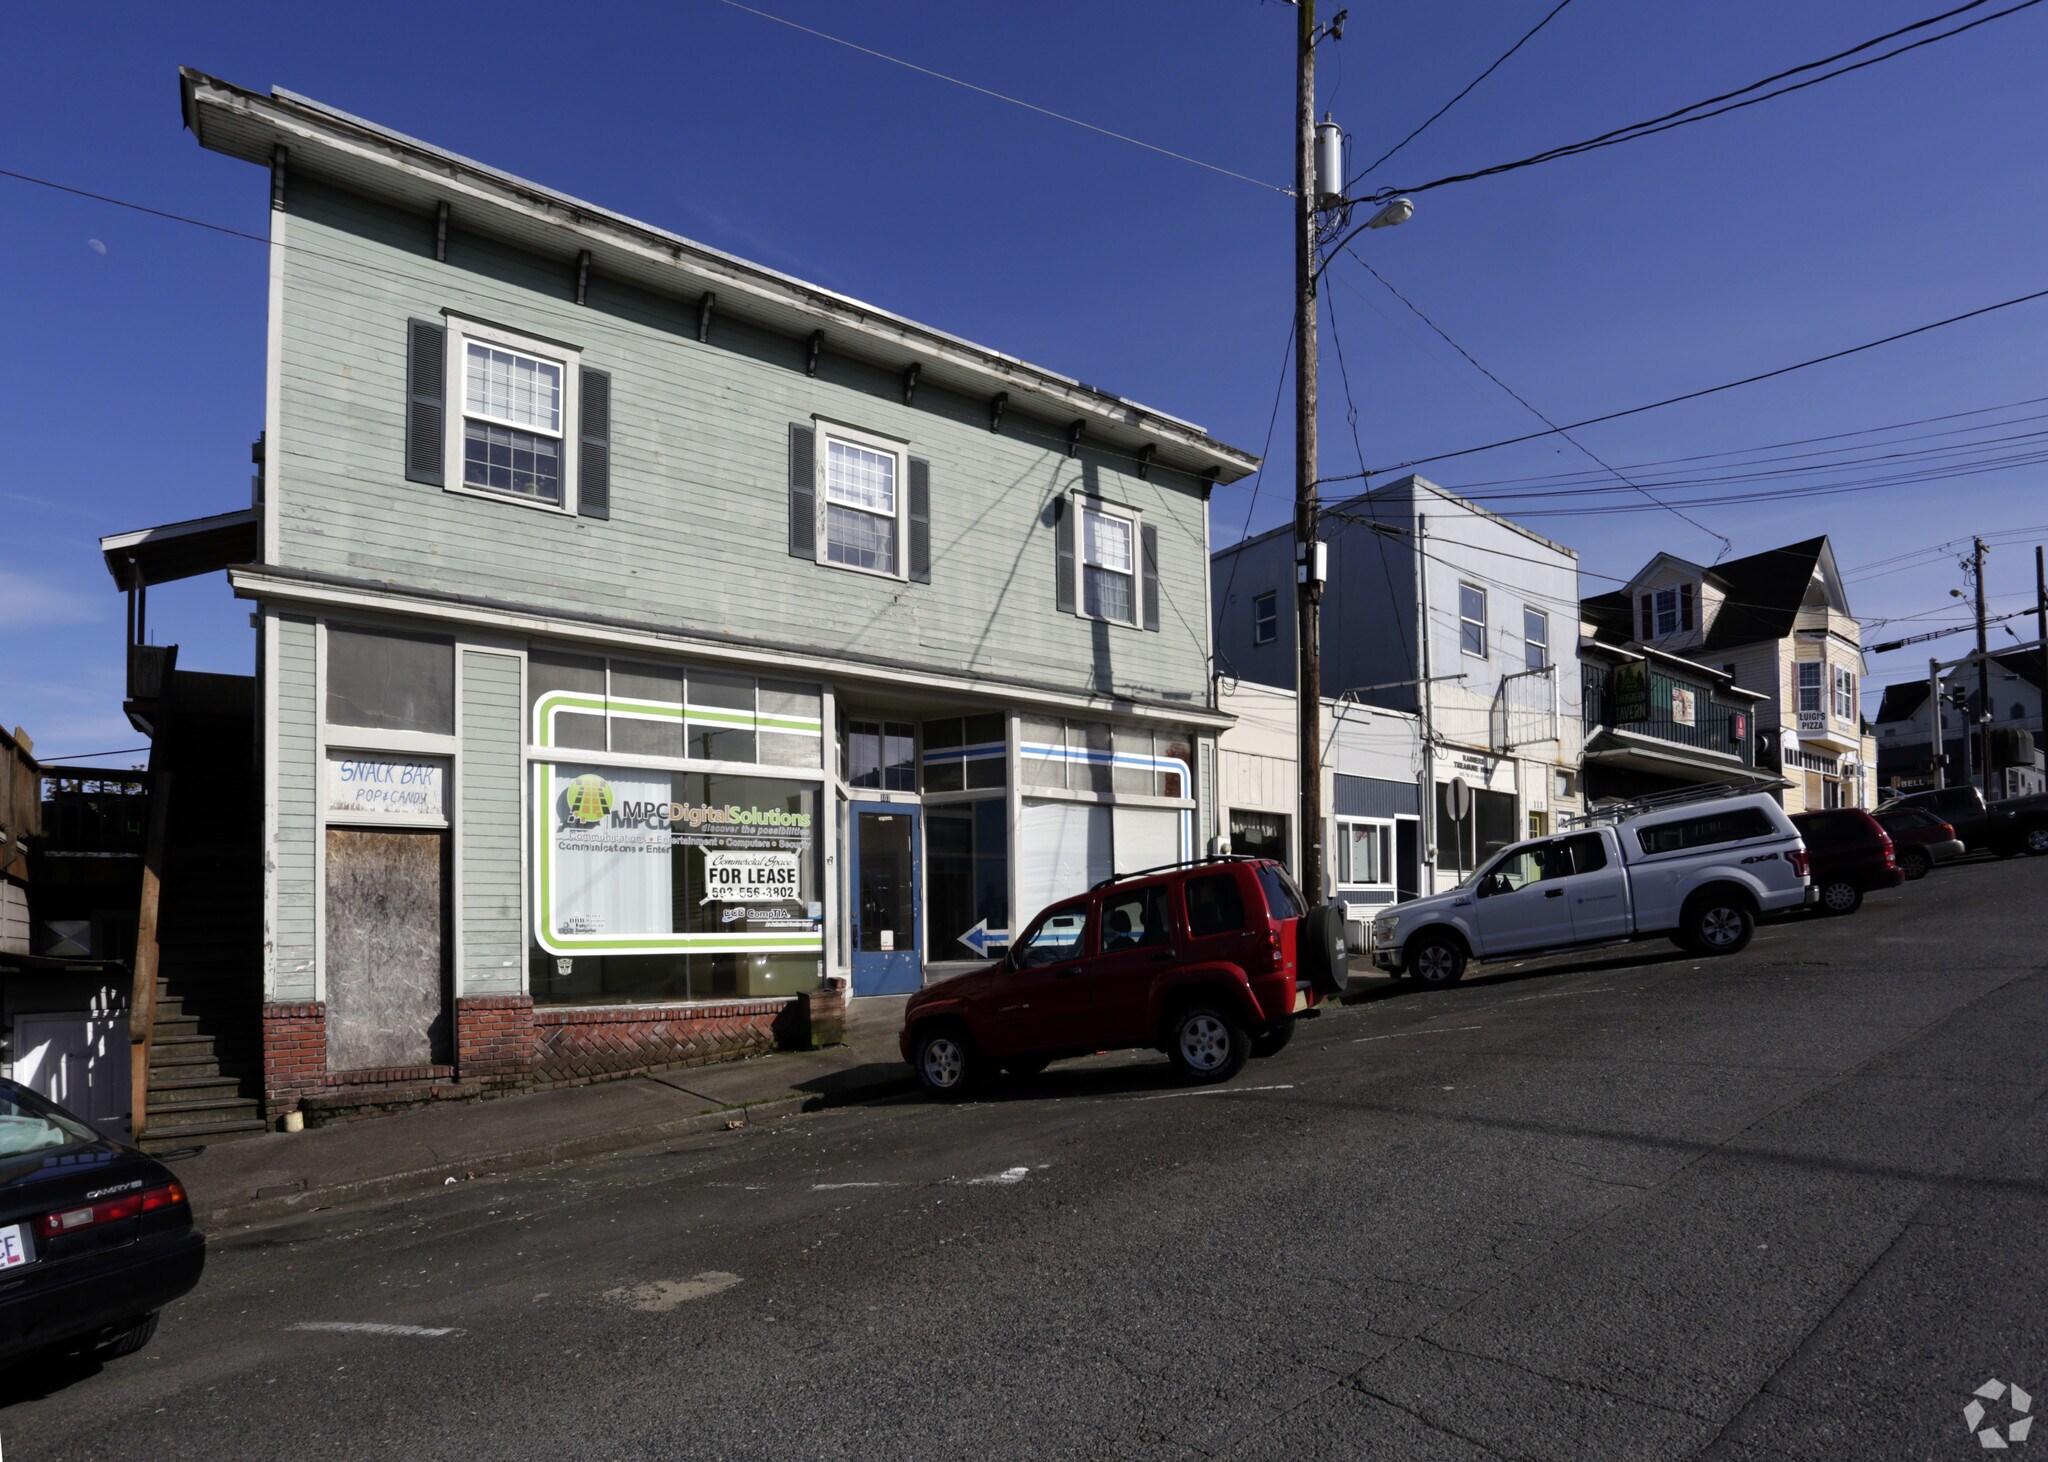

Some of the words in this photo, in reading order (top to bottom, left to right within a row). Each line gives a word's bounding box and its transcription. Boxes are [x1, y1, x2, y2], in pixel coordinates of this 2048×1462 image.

[1615, 703, 1647, 721] TAVERN
[1799, 712, 1826, 721] LUIGI'S
[1801, 721, 1824, 730] PIZZA
[341, 759, 397, 783] SNACK
[400, 763, 435, 785] BAR
[1900, 779, 1926, 788] BELL
[355, 788, 383, 802] POP
[702, 824, 740, 833] discover
[741, 825, 756, 834] the
[725, 838, 771, 849] Computers
[712, 855, 765, 867] Commercial
[764, 855, 793, 868] Space
[709, 868, 742, 884] FOR
[748, 868, 796, 884] LEASE
[711, 887, 795, 899] 503556-3802
[86, 1183, 131, 1198] CAMRY
